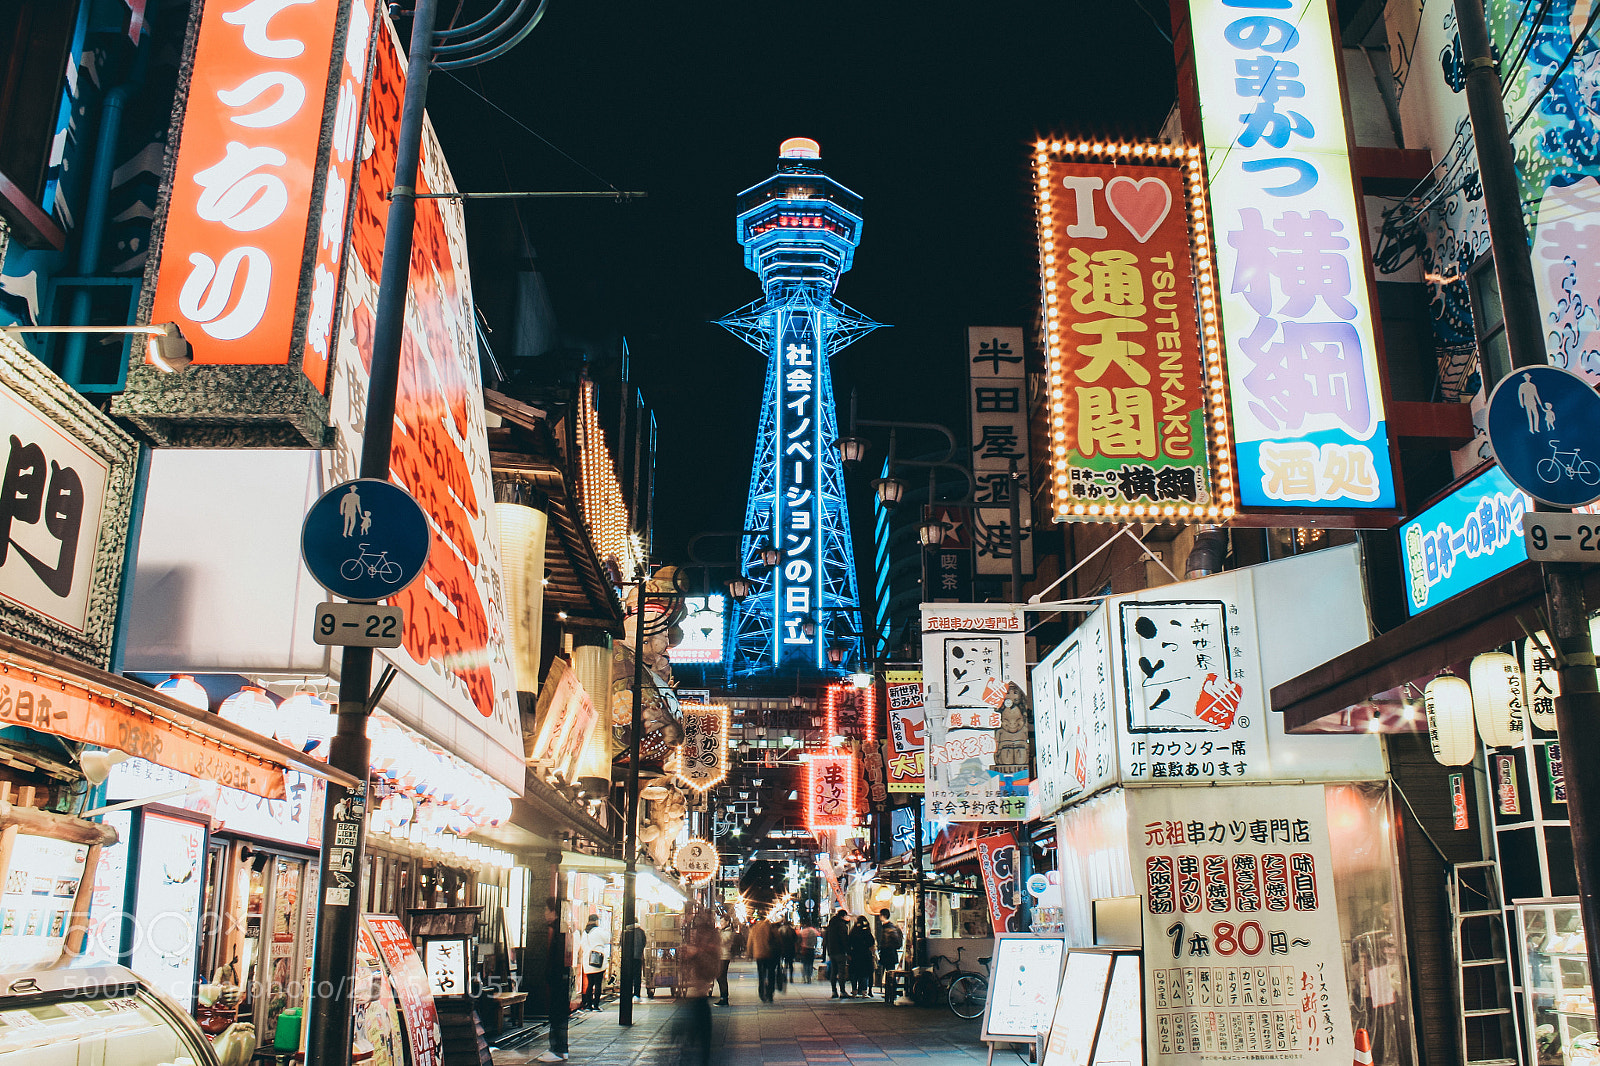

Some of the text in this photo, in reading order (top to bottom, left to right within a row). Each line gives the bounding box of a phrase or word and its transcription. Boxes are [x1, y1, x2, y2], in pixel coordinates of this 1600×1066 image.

[1227, 208, 1371, 434] 横綱
[1066, 248, 1157, 458] 通天閣
[1149, 251, 1193, 457] TSUTENKAKU
[1071, 470, 1117, 481] 日本一の
[1117, 465, 1196, 502] 横綱
[1263, 446, 1376, 498] 酒処
[784, 344, 813, 645] 社会イノベーションの日立
[1072, 483, 1117, 498] 串かつ
[1424, 492, 1527, 582] 日本一の串かつ
[941, 554, 959, 590] 喫茶
[927, 616, 1019, 630] 元祖串カツ専門店
[889, 685, 919, 698] 新世界
[700, 713, 721, 767] 串かつ
[930, 800, 1027, 815] 宴会予約受付中
[1144, 818, 1311, 847] 元祖串カツ専門店
[1149, 857, 1173, 914] 大阪名物
[1178, 856, 1202, 913] 串カツ
[1206, 856, 1230, 912] どて焼き
[1234, 856, 1260, 911] 焼きそば
[1263, 856, 1288, 911] たこ焼き
[1292, 855, 1317, 911] 味自慢
[435, 944, 456, 992] ぎふや
[1286, 975, 1295, 997] たこ
[1172, 980, 1181, 999] ハム
[1215, 972, 1223, 1004] いわし
[1228, 971, 1237, 1004] ホタテ
[1242, 971, 1253, 1003] カニ爪
[1257, 970, 1267, 1004] ししゃも
[1272, 977, 1281, 998] いか
[1316, 962, 1335, 1046] ソースの二度つけ
[1160, 1016, 1170, 1053] れんこん
[1175, 1016, 1184, 1052] じゃがいも
[1276, 1014, 1285, 1049] おにぎり
[1289, 1014, 1298, 1046] キムチ
